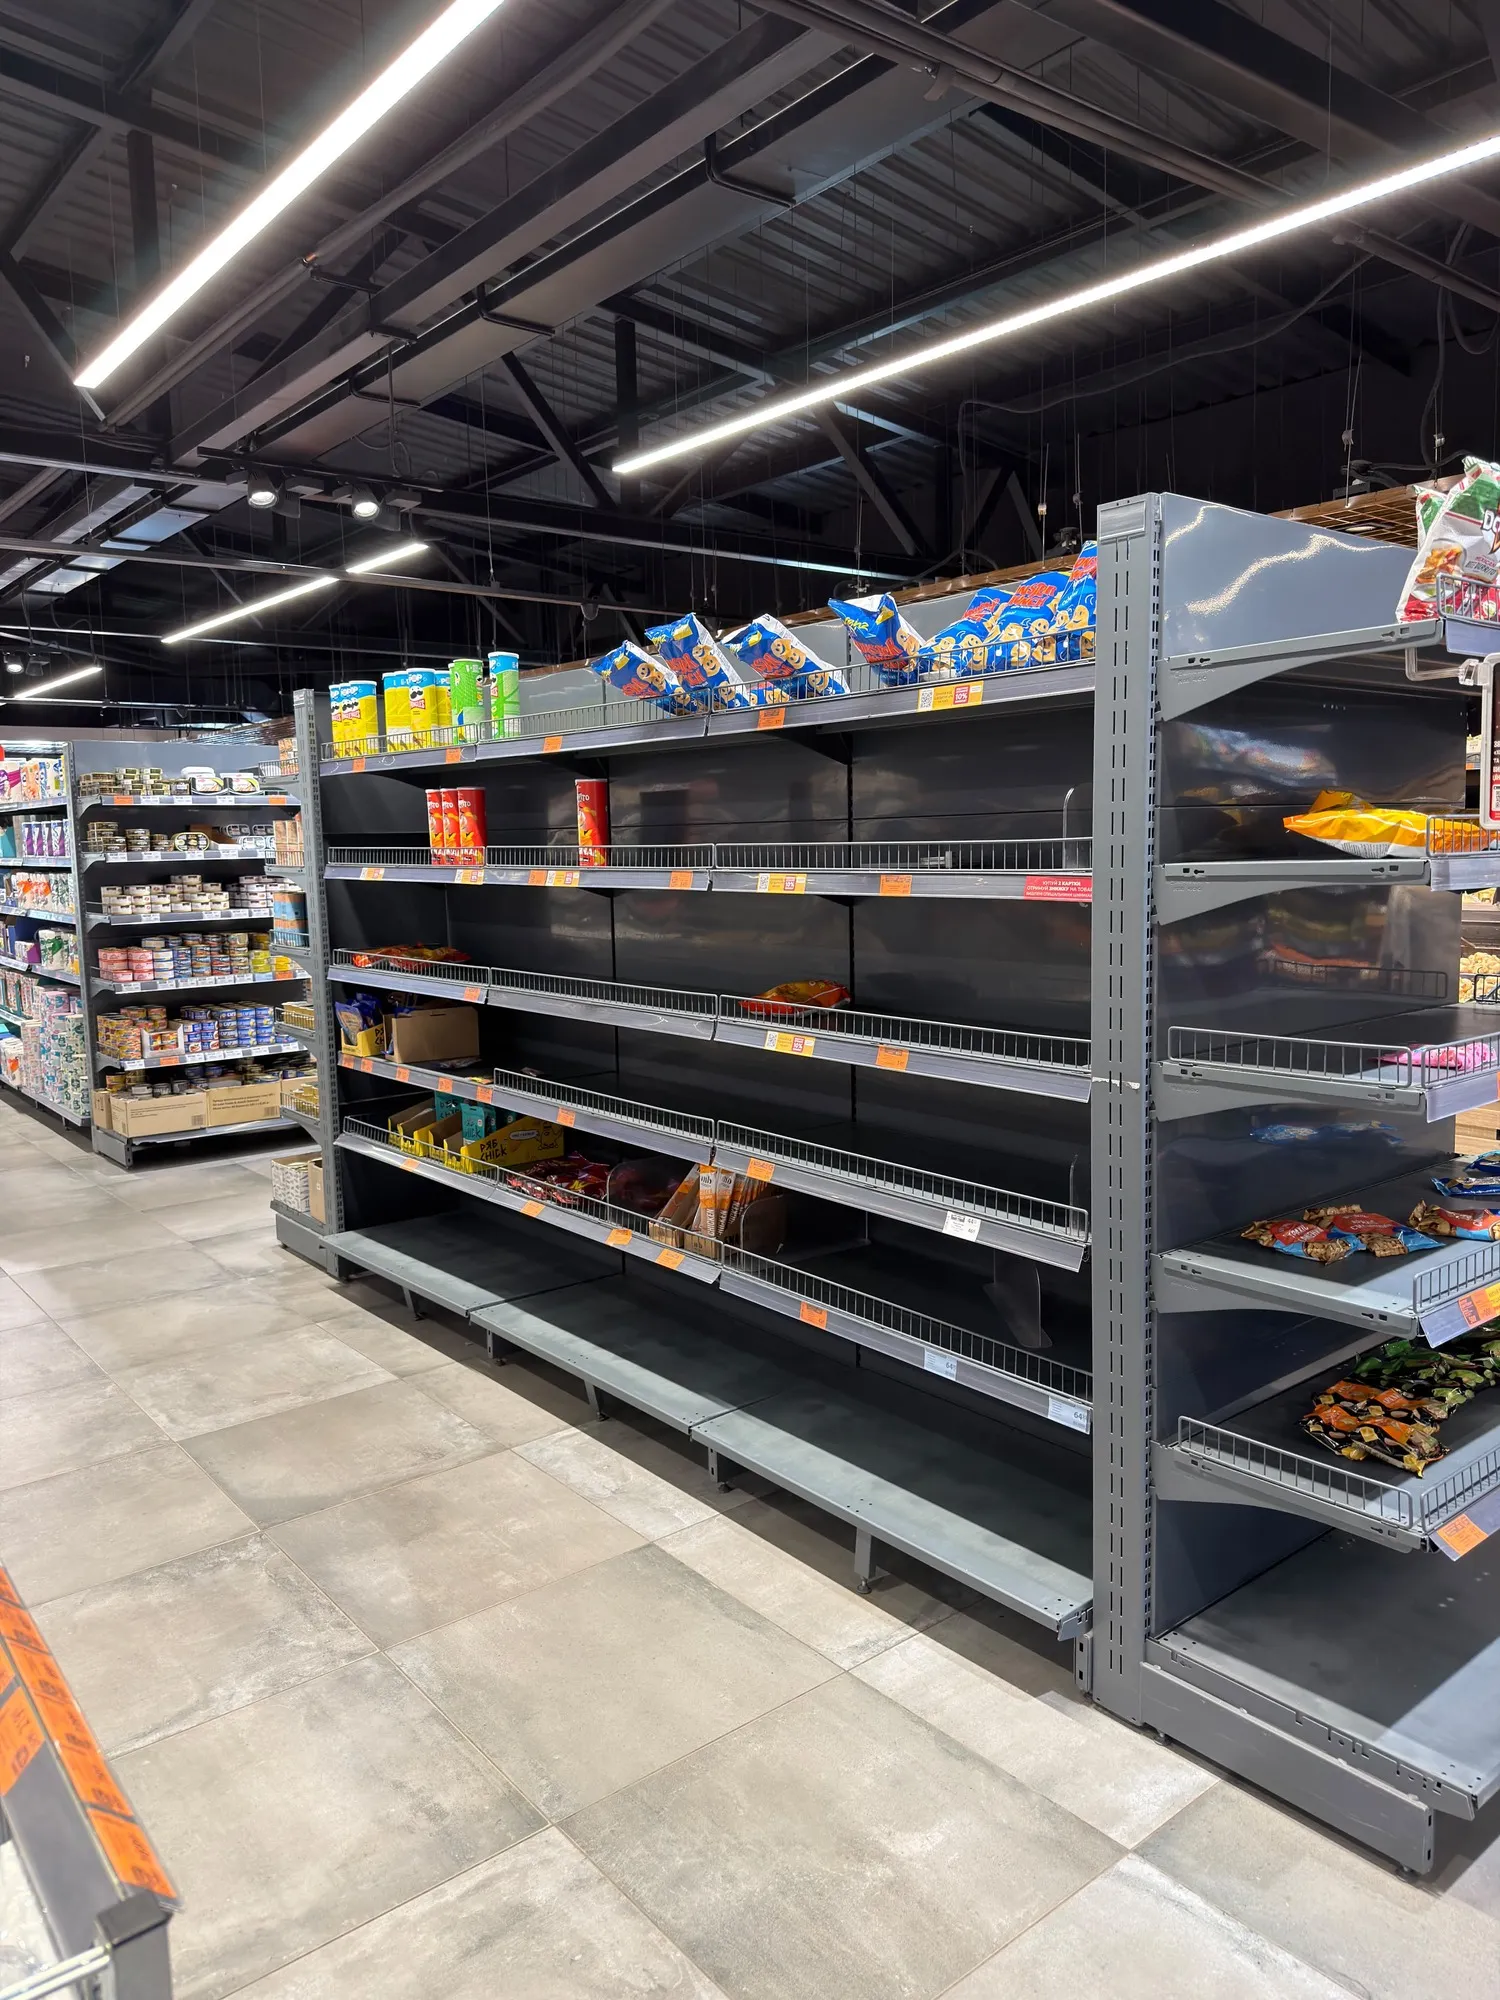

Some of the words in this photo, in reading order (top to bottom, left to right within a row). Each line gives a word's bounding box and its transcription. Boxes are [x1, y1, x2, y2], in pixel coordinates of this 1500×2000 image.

[955, 693, 967, 701] 10%
[480, 1145, 507, 1161] CHICK
[706, 1208, 715, 1236] CHICKEN
